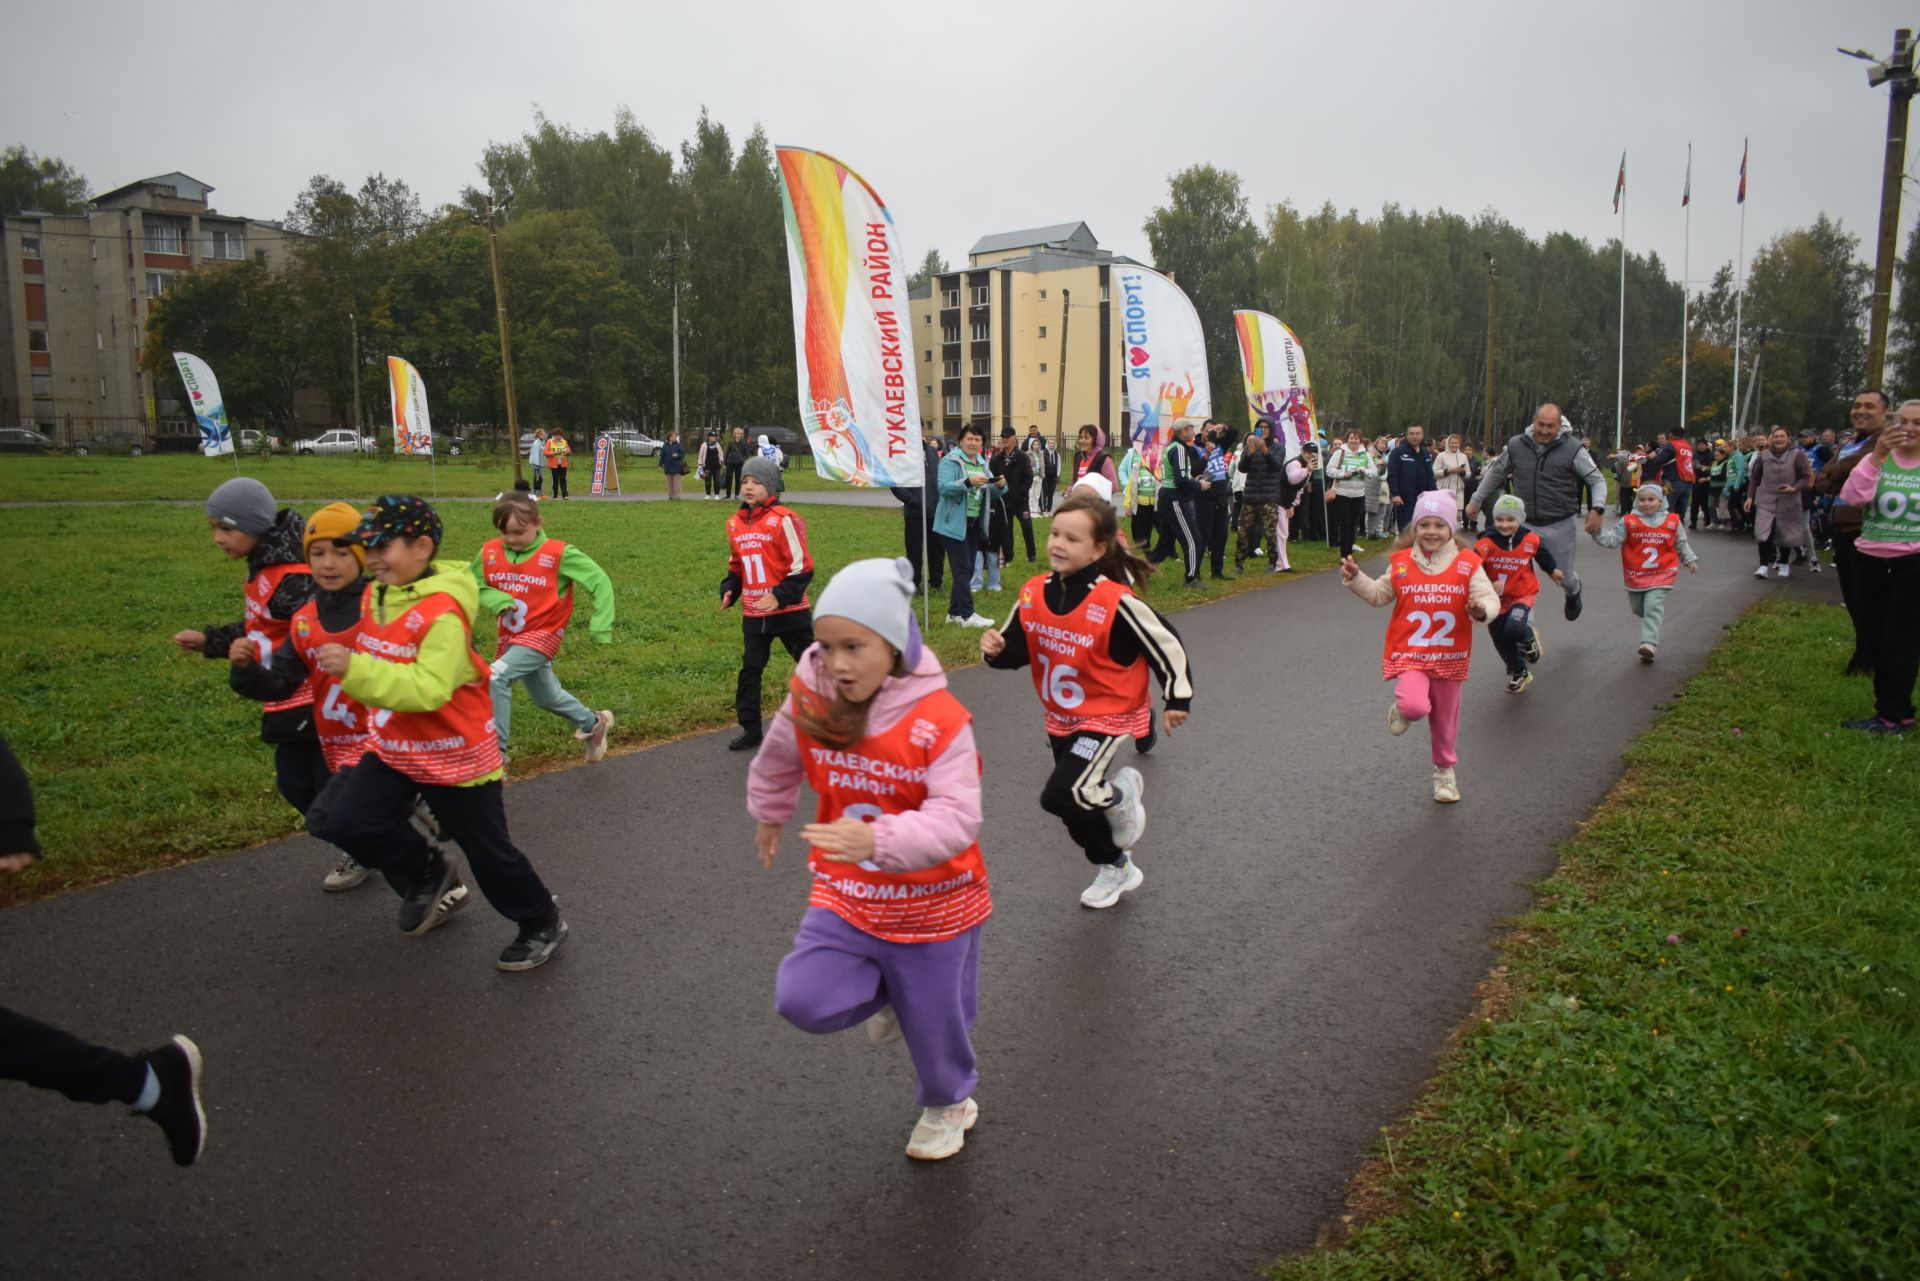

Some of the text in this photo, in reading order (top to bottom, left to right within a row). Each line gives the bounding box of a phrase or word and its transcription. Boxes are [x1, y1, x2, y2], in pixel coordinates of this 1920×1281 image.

[863, 223, 907, 458] ТУКАЕВСКИЙ РАЙОН
[1122, 275, 1151, 379] Я СПОРТ!
[1284, 338, 1298, 374] СПОРТА!
[592, 437, 608, 494] ФИНИШ
[741, 553, 767, 585] 11
[1642, 547, 1659, 569] 2
[498, 581, 529, 593] РАЙОН
[1400, 583, 1466, 595] ТУКАЕВСКИЙ
[1414, 593, 1451, 604] РАЙОН
[1406, 610, 1456, 647] 22
[1038, 637, 1076, 657] РАЙОН
[1037, 653, 1085, 709] 16
[810, 748, 929, 784] ТУКАЕВСКИЙ
[828, 770, 896, 796] РАЙОН
[841, 869, 973, 899] НОРМА ЖИЗНИ
